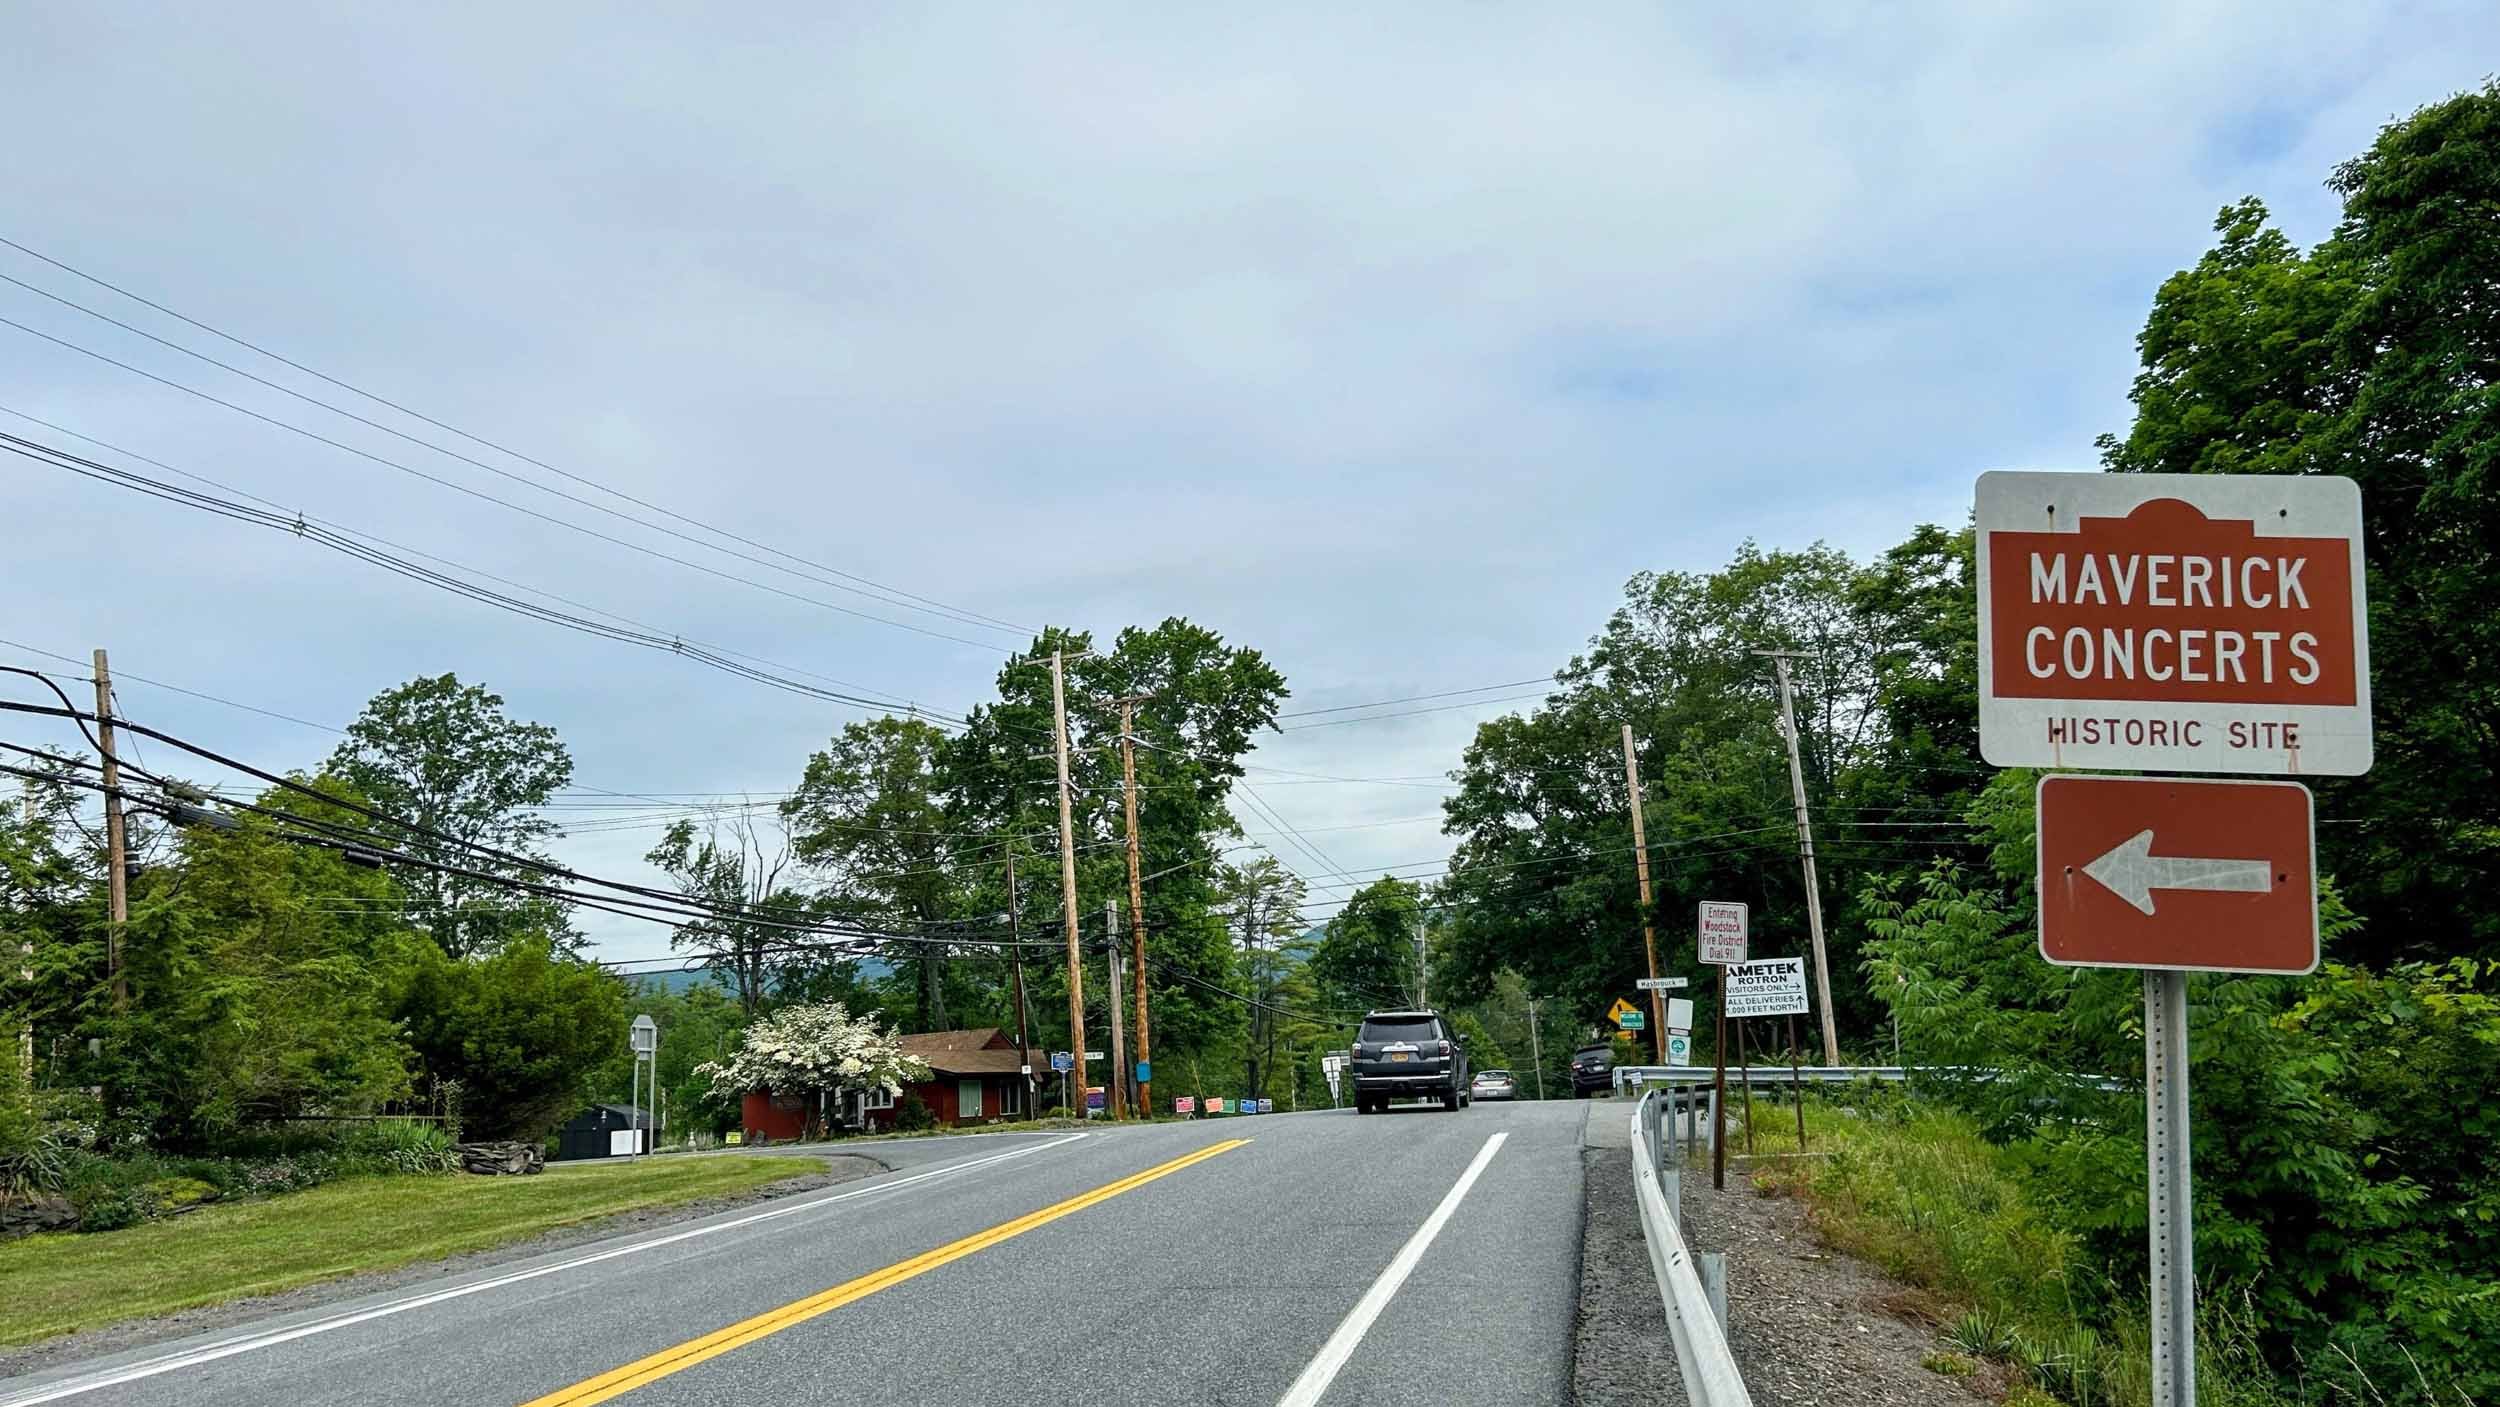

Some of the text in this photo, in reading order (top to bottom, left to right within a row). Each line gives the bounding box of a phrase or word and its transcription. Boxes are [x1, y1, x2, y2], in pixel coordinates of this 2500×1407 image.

[2030, 552, 2310, 609] MAVERICK
[2026, 626, 2320, 685] CONCERTS
[2048, 717, 2300, 750] HISTORIC SITE
[1708, 907, 1738, 920] Entering
[1704, 920, 1741, 933] Woodstock
[1702, 932, 1743, 946] Fire District
[1709, 946, 1735, 960] Dial 911
[1727, 962, 1798, 977] AMETEK
[1738, 975, 1787, 985] ROTRON
[1726, 984, 1789, 994] VISITORS ONLY
[1745, 995, 1794, 1005] DELIVERIES
[1748, 1004, 1768, 1013] FEET
[1770, 1003, 1798, 1012] NORTH
